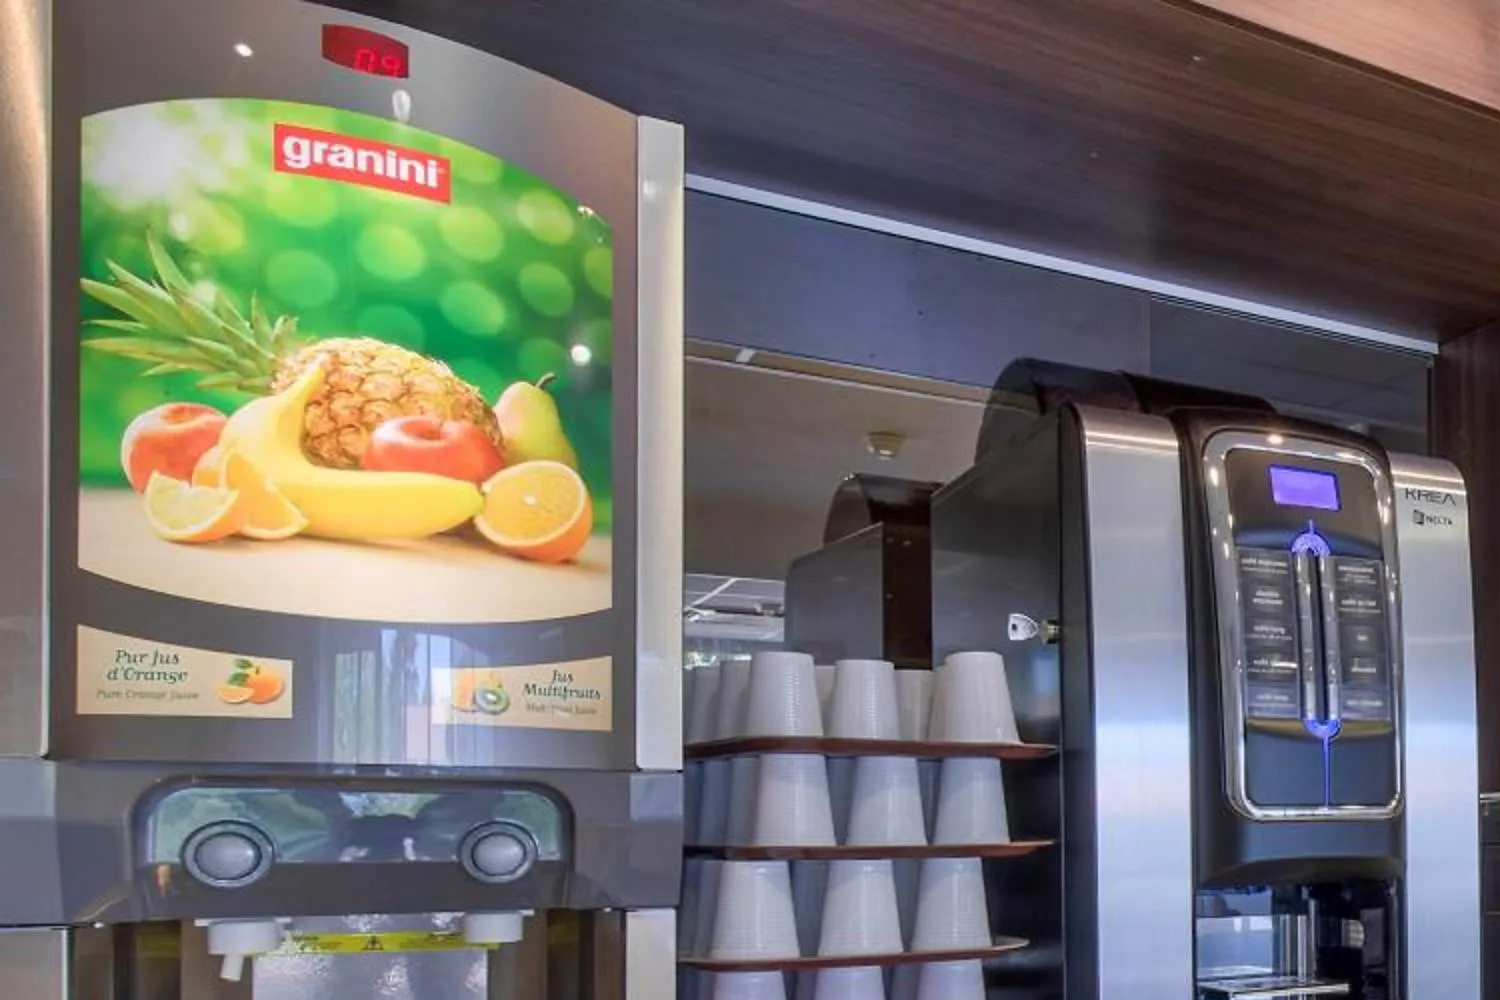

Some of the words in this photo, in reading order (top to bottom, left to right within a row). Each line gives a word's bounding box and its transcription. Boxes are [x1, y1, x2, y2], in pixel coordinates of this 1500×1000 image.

[282, 134, 439, 189] granini
[1405, 488, 1456, 506] KREA
[114, 649, 148, 664] Pur
[152, 649, 180, 667] Jus
[106, 667, 189, 684] d'Orange
[551, 669, 574, 684] Jus
[523, 683, 601, 700] Multifruits
